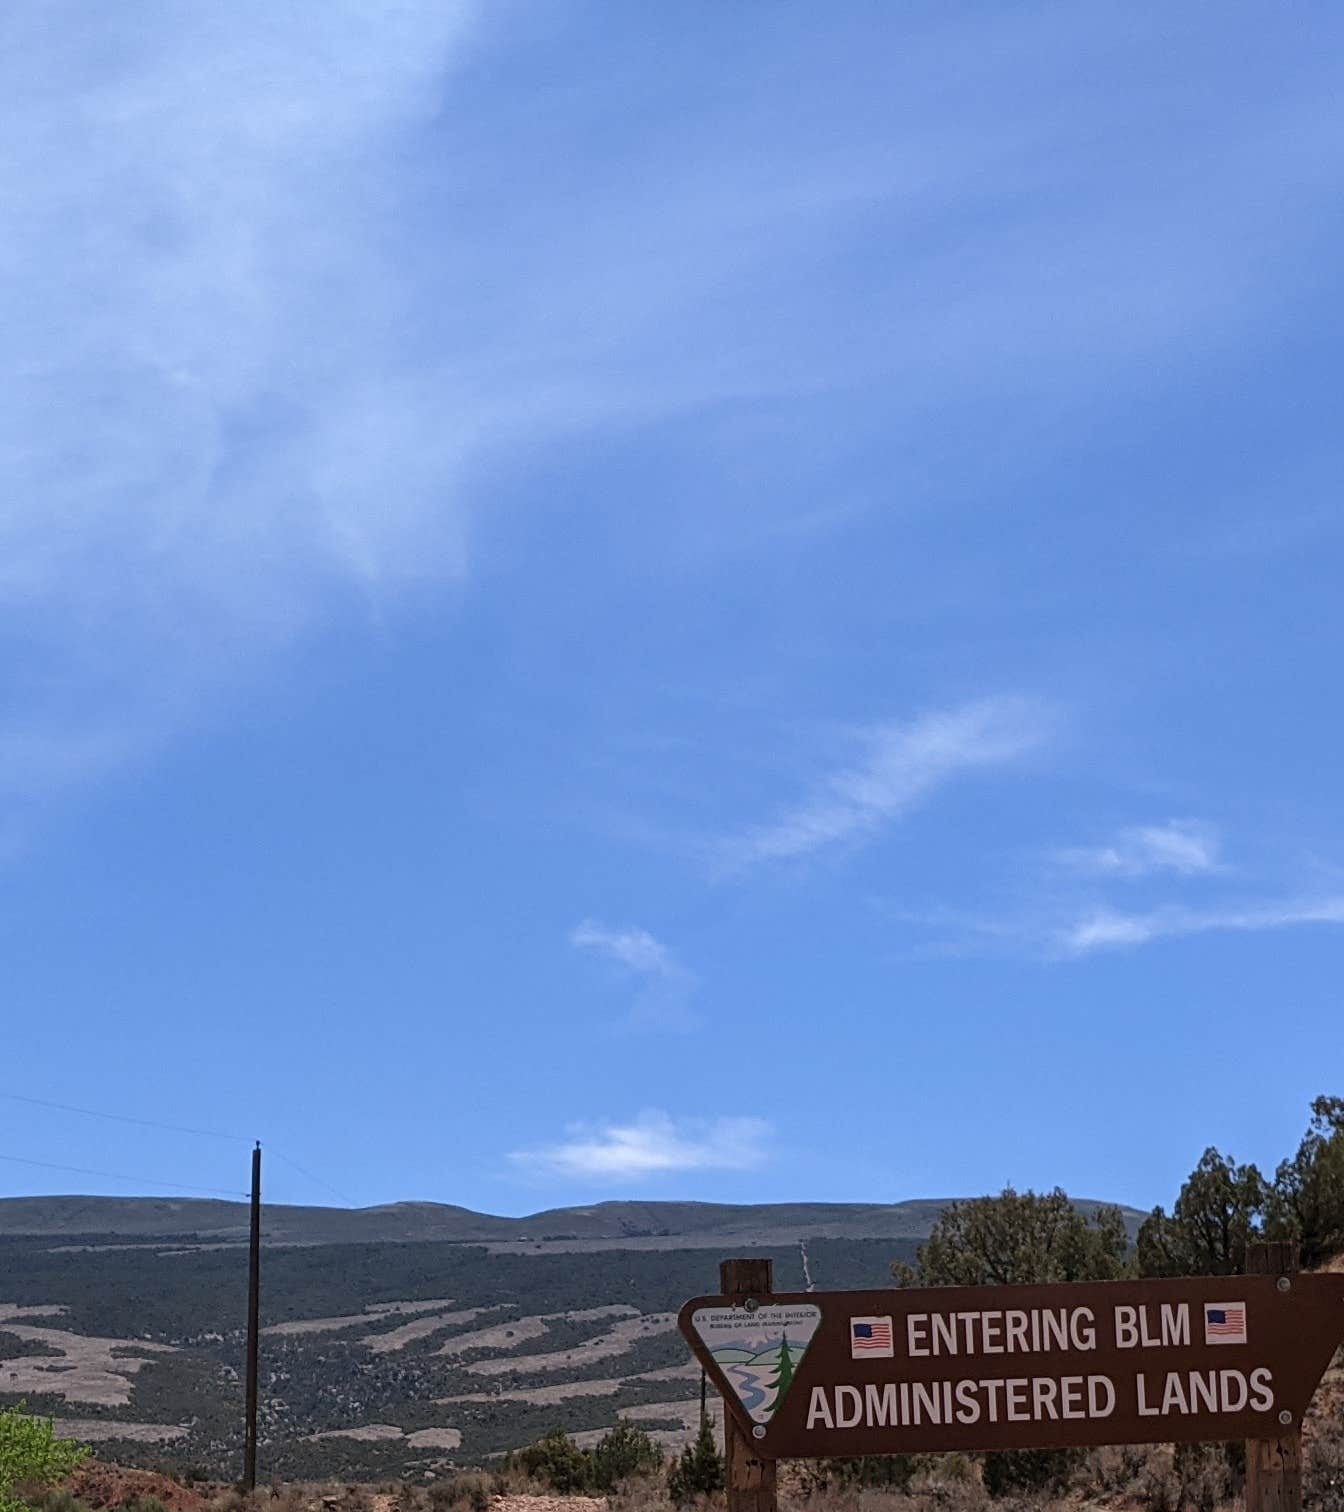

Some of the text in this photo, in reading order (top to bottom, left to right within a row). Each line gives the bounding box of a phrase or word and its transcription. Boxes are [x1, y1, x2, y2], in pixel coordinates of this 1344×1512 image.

[758, 1312, 768, 1320] OF
[908, 1303, 1190, 1356] ENTERING BLM
[806, 1367, 1274, 1429] ADMINISTERED LANDS
